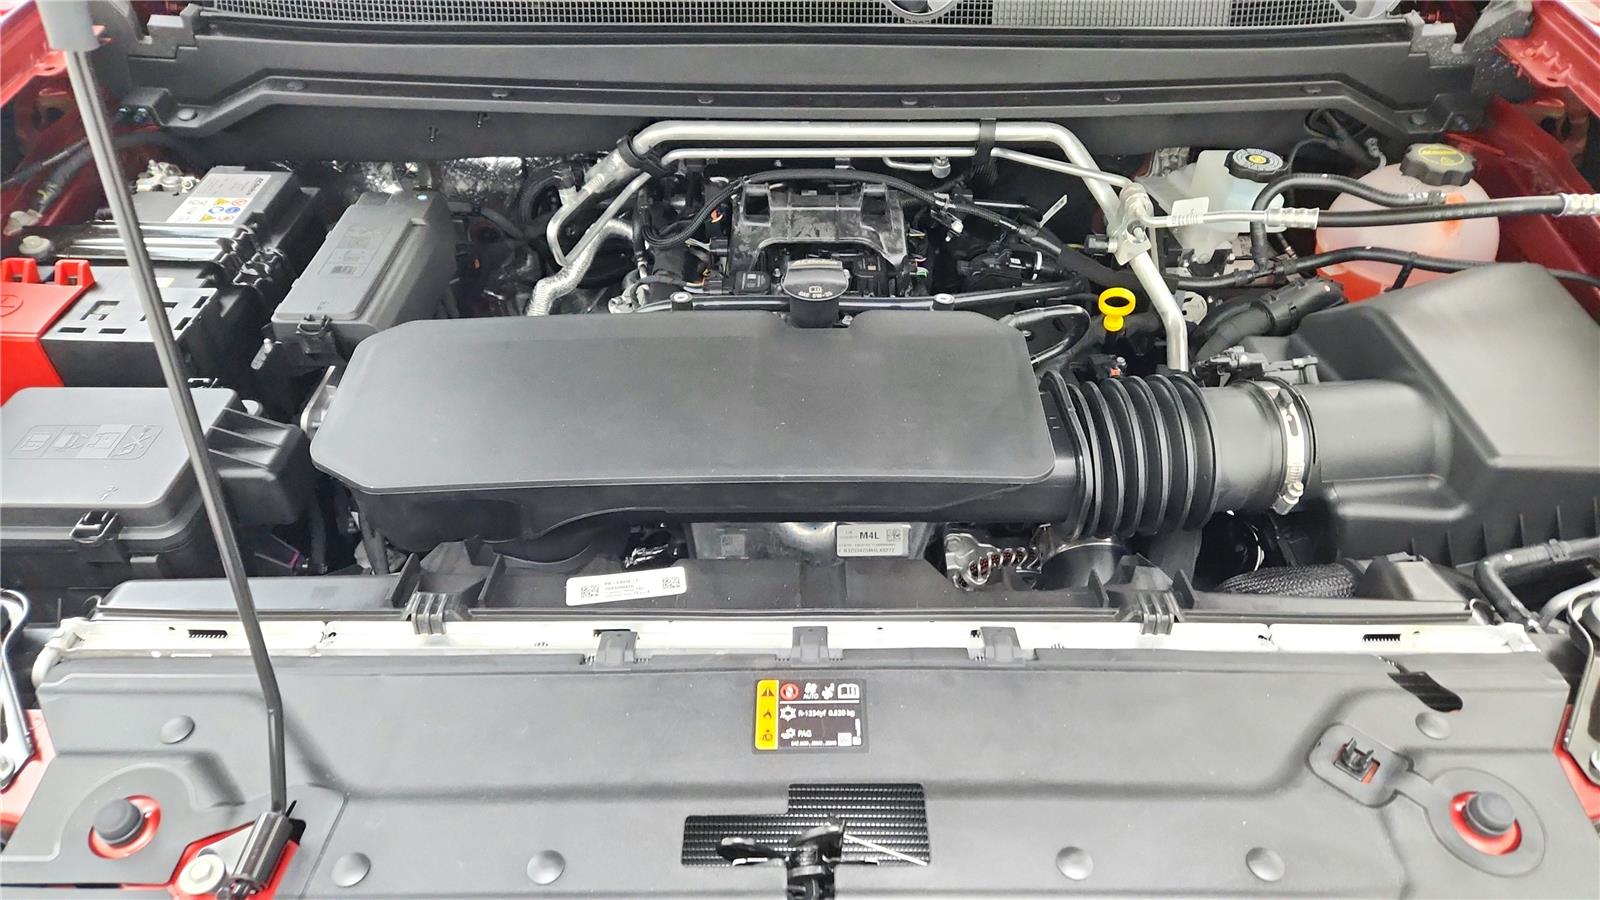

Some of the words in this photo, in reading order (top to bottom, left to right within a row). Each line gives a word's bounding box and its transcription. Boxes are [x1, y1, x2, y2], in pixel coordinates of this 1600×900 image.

[860, 531, 880, 539] M4L
[847, 709, 855, 718] kg
[797, 730, 812, 738] PAG
